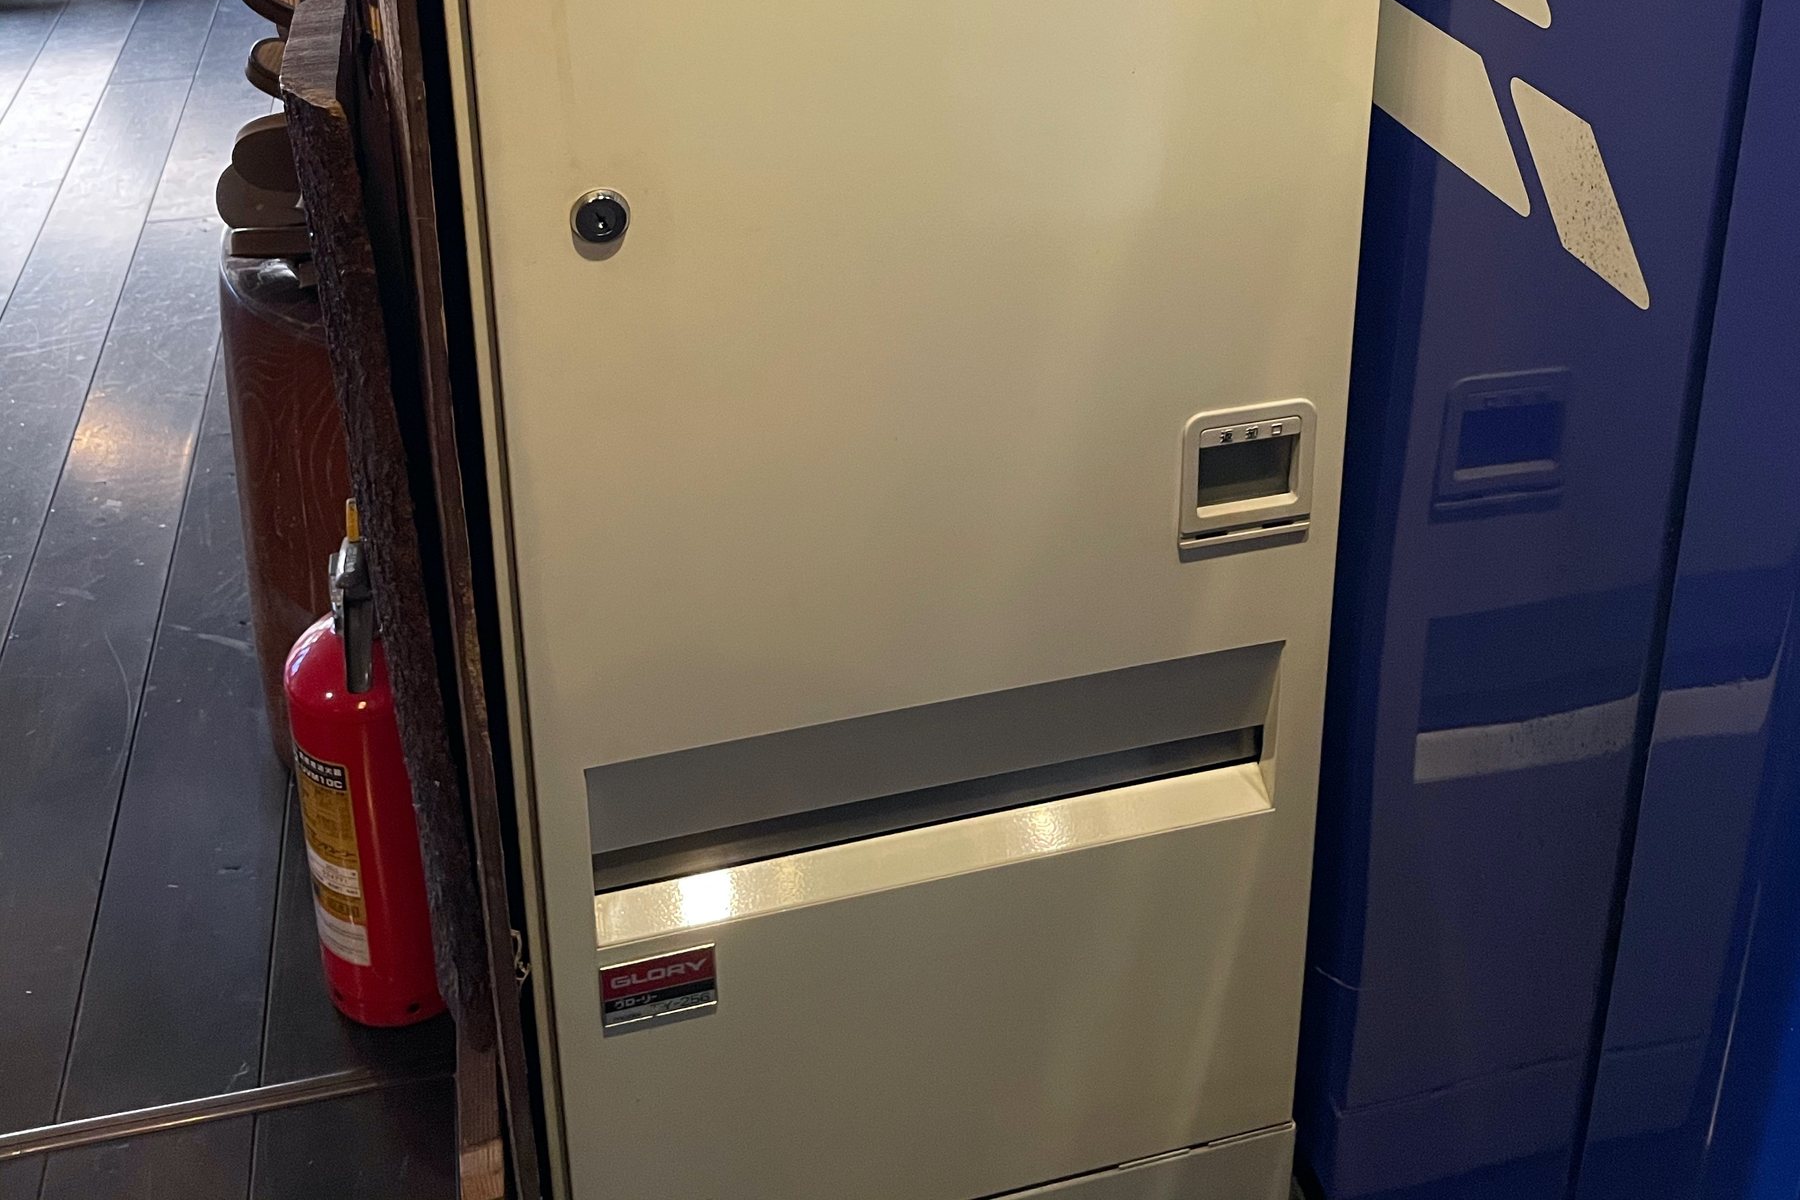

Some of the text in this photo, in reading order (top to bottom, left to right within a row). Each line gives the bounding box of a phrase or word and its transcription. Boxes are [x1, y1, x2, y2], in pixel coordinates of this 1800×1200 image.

[610, 958, 707, 990] GLORY
[614, 993, 658, 1010] グローリー
